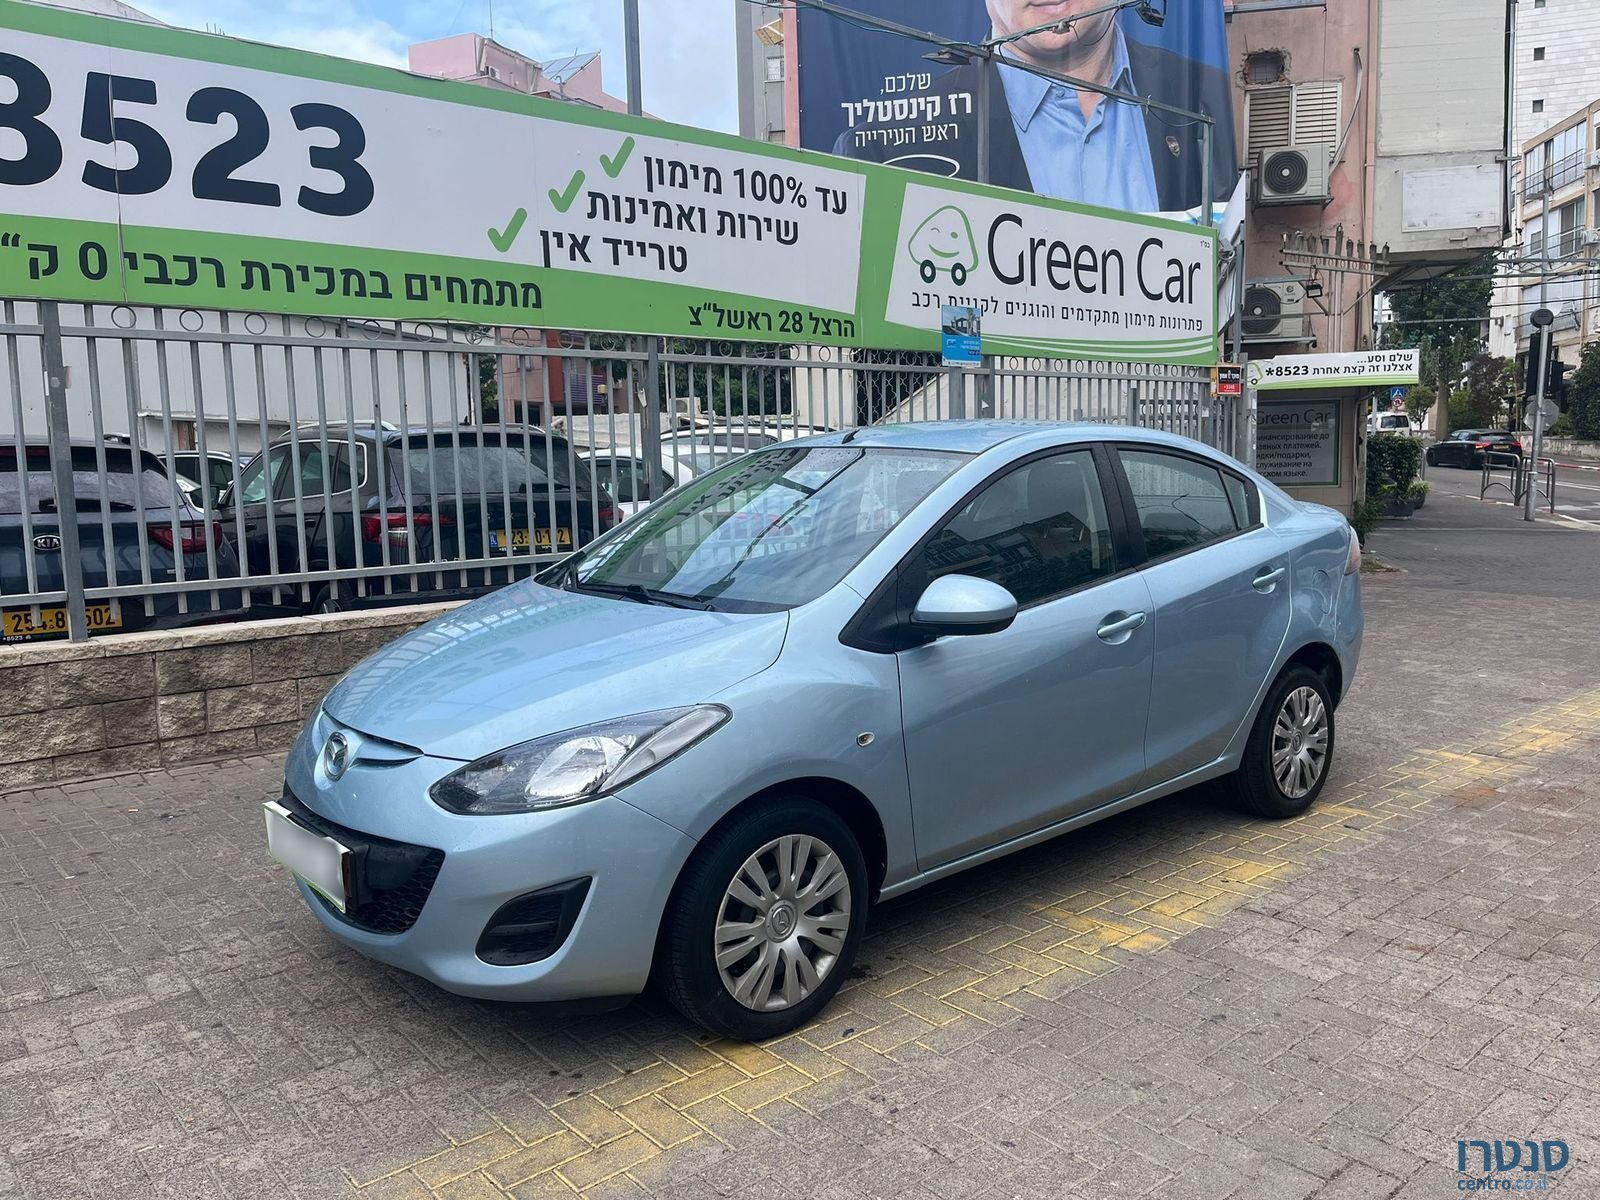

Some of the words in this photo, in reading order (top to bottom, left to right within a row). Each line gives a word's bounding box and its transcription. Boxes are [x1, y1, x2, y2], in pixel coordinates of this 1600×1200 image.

[879, 73, 931, 95] שלכם,
[841, 96, 941, 127] קינסטליך
[948, 92, 972, 115] רז
[855, 126, 916, 147] העירייה
[921, 123, 959, 143] ראש
[644, 156, 722, 195] מימון
[733, 168, 807, 208] 100%
[587, 191, 707, 234] ואמינות
[815, 185, 847, 215] עד
[717, 209, 799, 246] שירות
[540, 229, 592, 268] אין
[602, 236, 688, 273] טרייד
[987, 213, 1125, 297] Green
[1136, 237, 1201, 304] Car
[123, 248, 226, 289] רכבי
[241, 259, 393, 300] במכירת
[405, 274, 543, 309] מתמחים
[911, 291, 941, 309] רכב
[688, 303, 773, 334] ראשל"צ
[779, 309, 803, 334] 28
[1005, 301, 1055, 319] והוגנים
[1060, 306, 1120, 326] מתקדמים
[1124, 312, 1156, 329] מימון
[808, 310, 857, 338] הרצל
[1159, 316, 1204, 332] פתרונות
[1343, 364, 1365, 376] קצת
[1368, 364, 1380, 373] זה
[1383, 362, 1413, 372] אצלנו
[1389, 353, 1413, 362] שלם
[1312, 367, 1340, 375] אחרת
